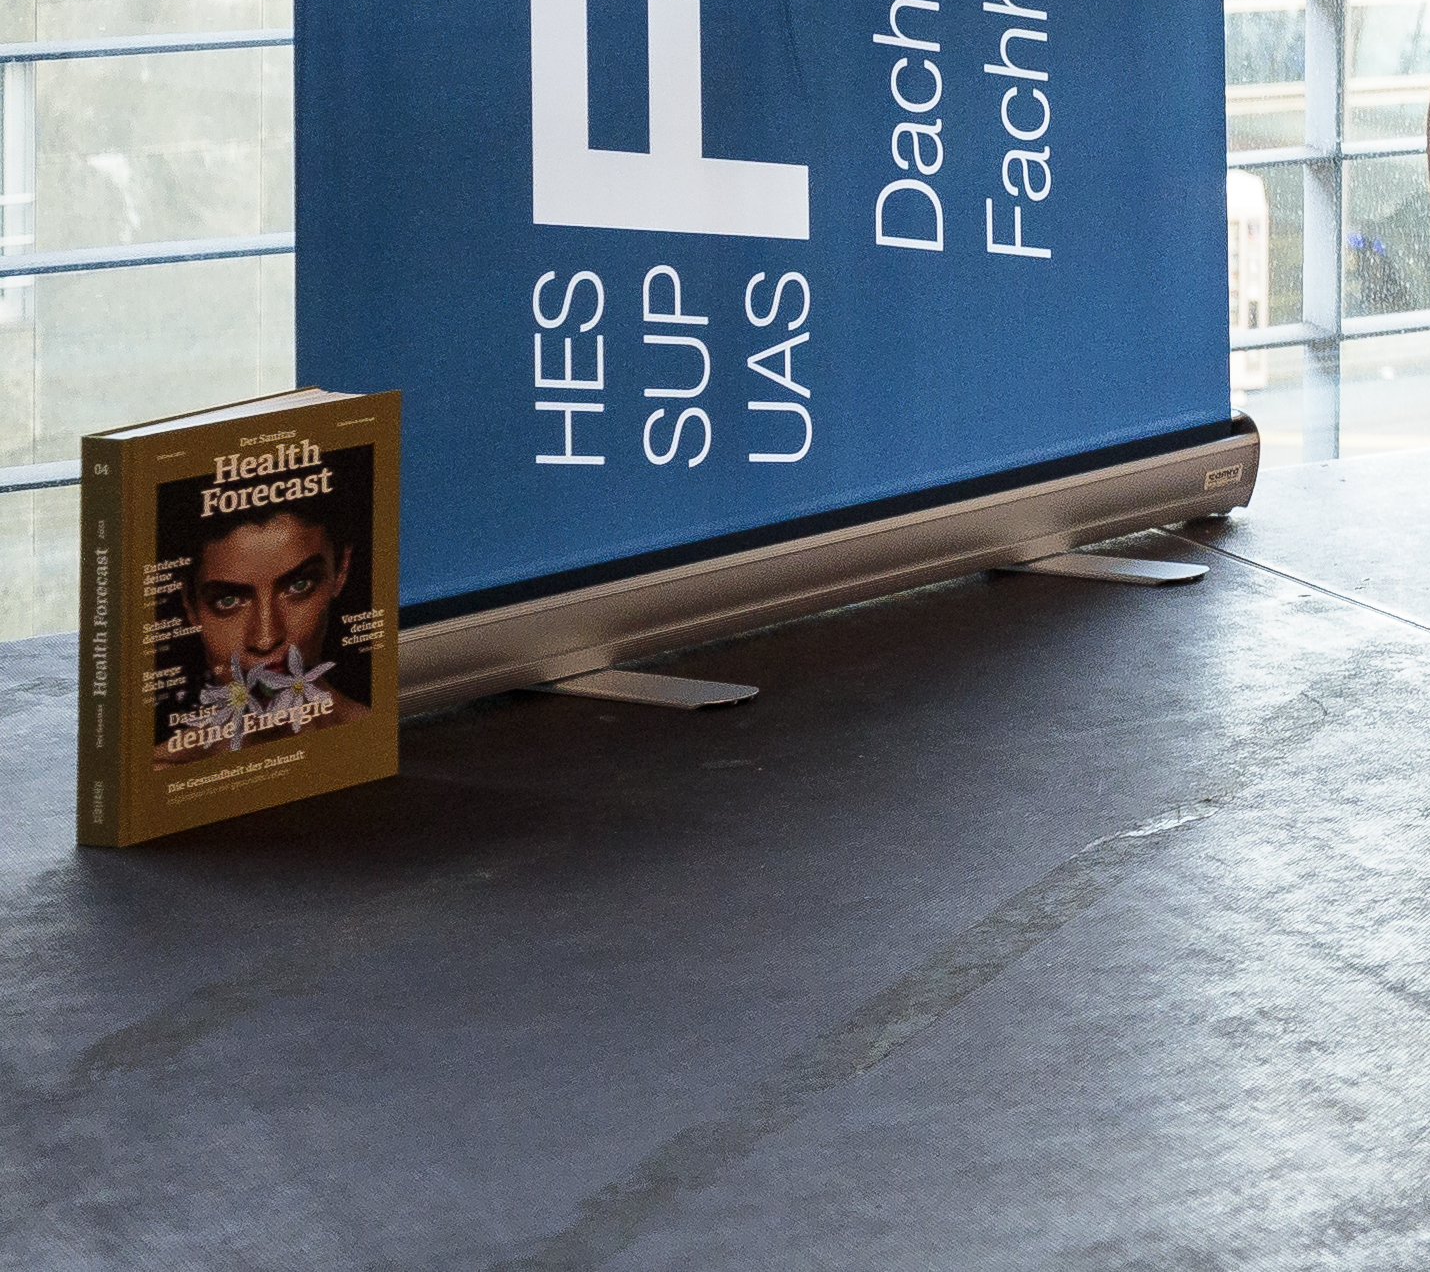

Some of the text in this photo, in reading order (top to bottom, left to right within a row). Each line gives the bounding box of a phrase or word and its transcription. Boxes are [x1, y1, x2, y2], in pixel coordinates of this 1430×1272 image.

[532, 270, 605, 465] HES
[642, 265, 712, 468] SUP
[745, 271, 813, 463] UAS
[213, 439, 322, 484] Health
[201, 468, 333, 518] Forecast
[94, 549, 109, 628] Forecast
[143, 557, 192, 574] Entdecke
[143, 580, 183, 596] Energie
[341, 609, 385, 624] Verstehe
[350, 620, 384, 633] deinen
[93, 632, 108, 696] Health
[167, 697, 334, 754] deine Energie
[169, 705, 218, 727] Das ist
[168, 783, 185, 794] Die
[187, 766, 244, 788] Gesundheit
[246, 762, 263, 773] der
[264, 750, 306, 769] Zukunft
